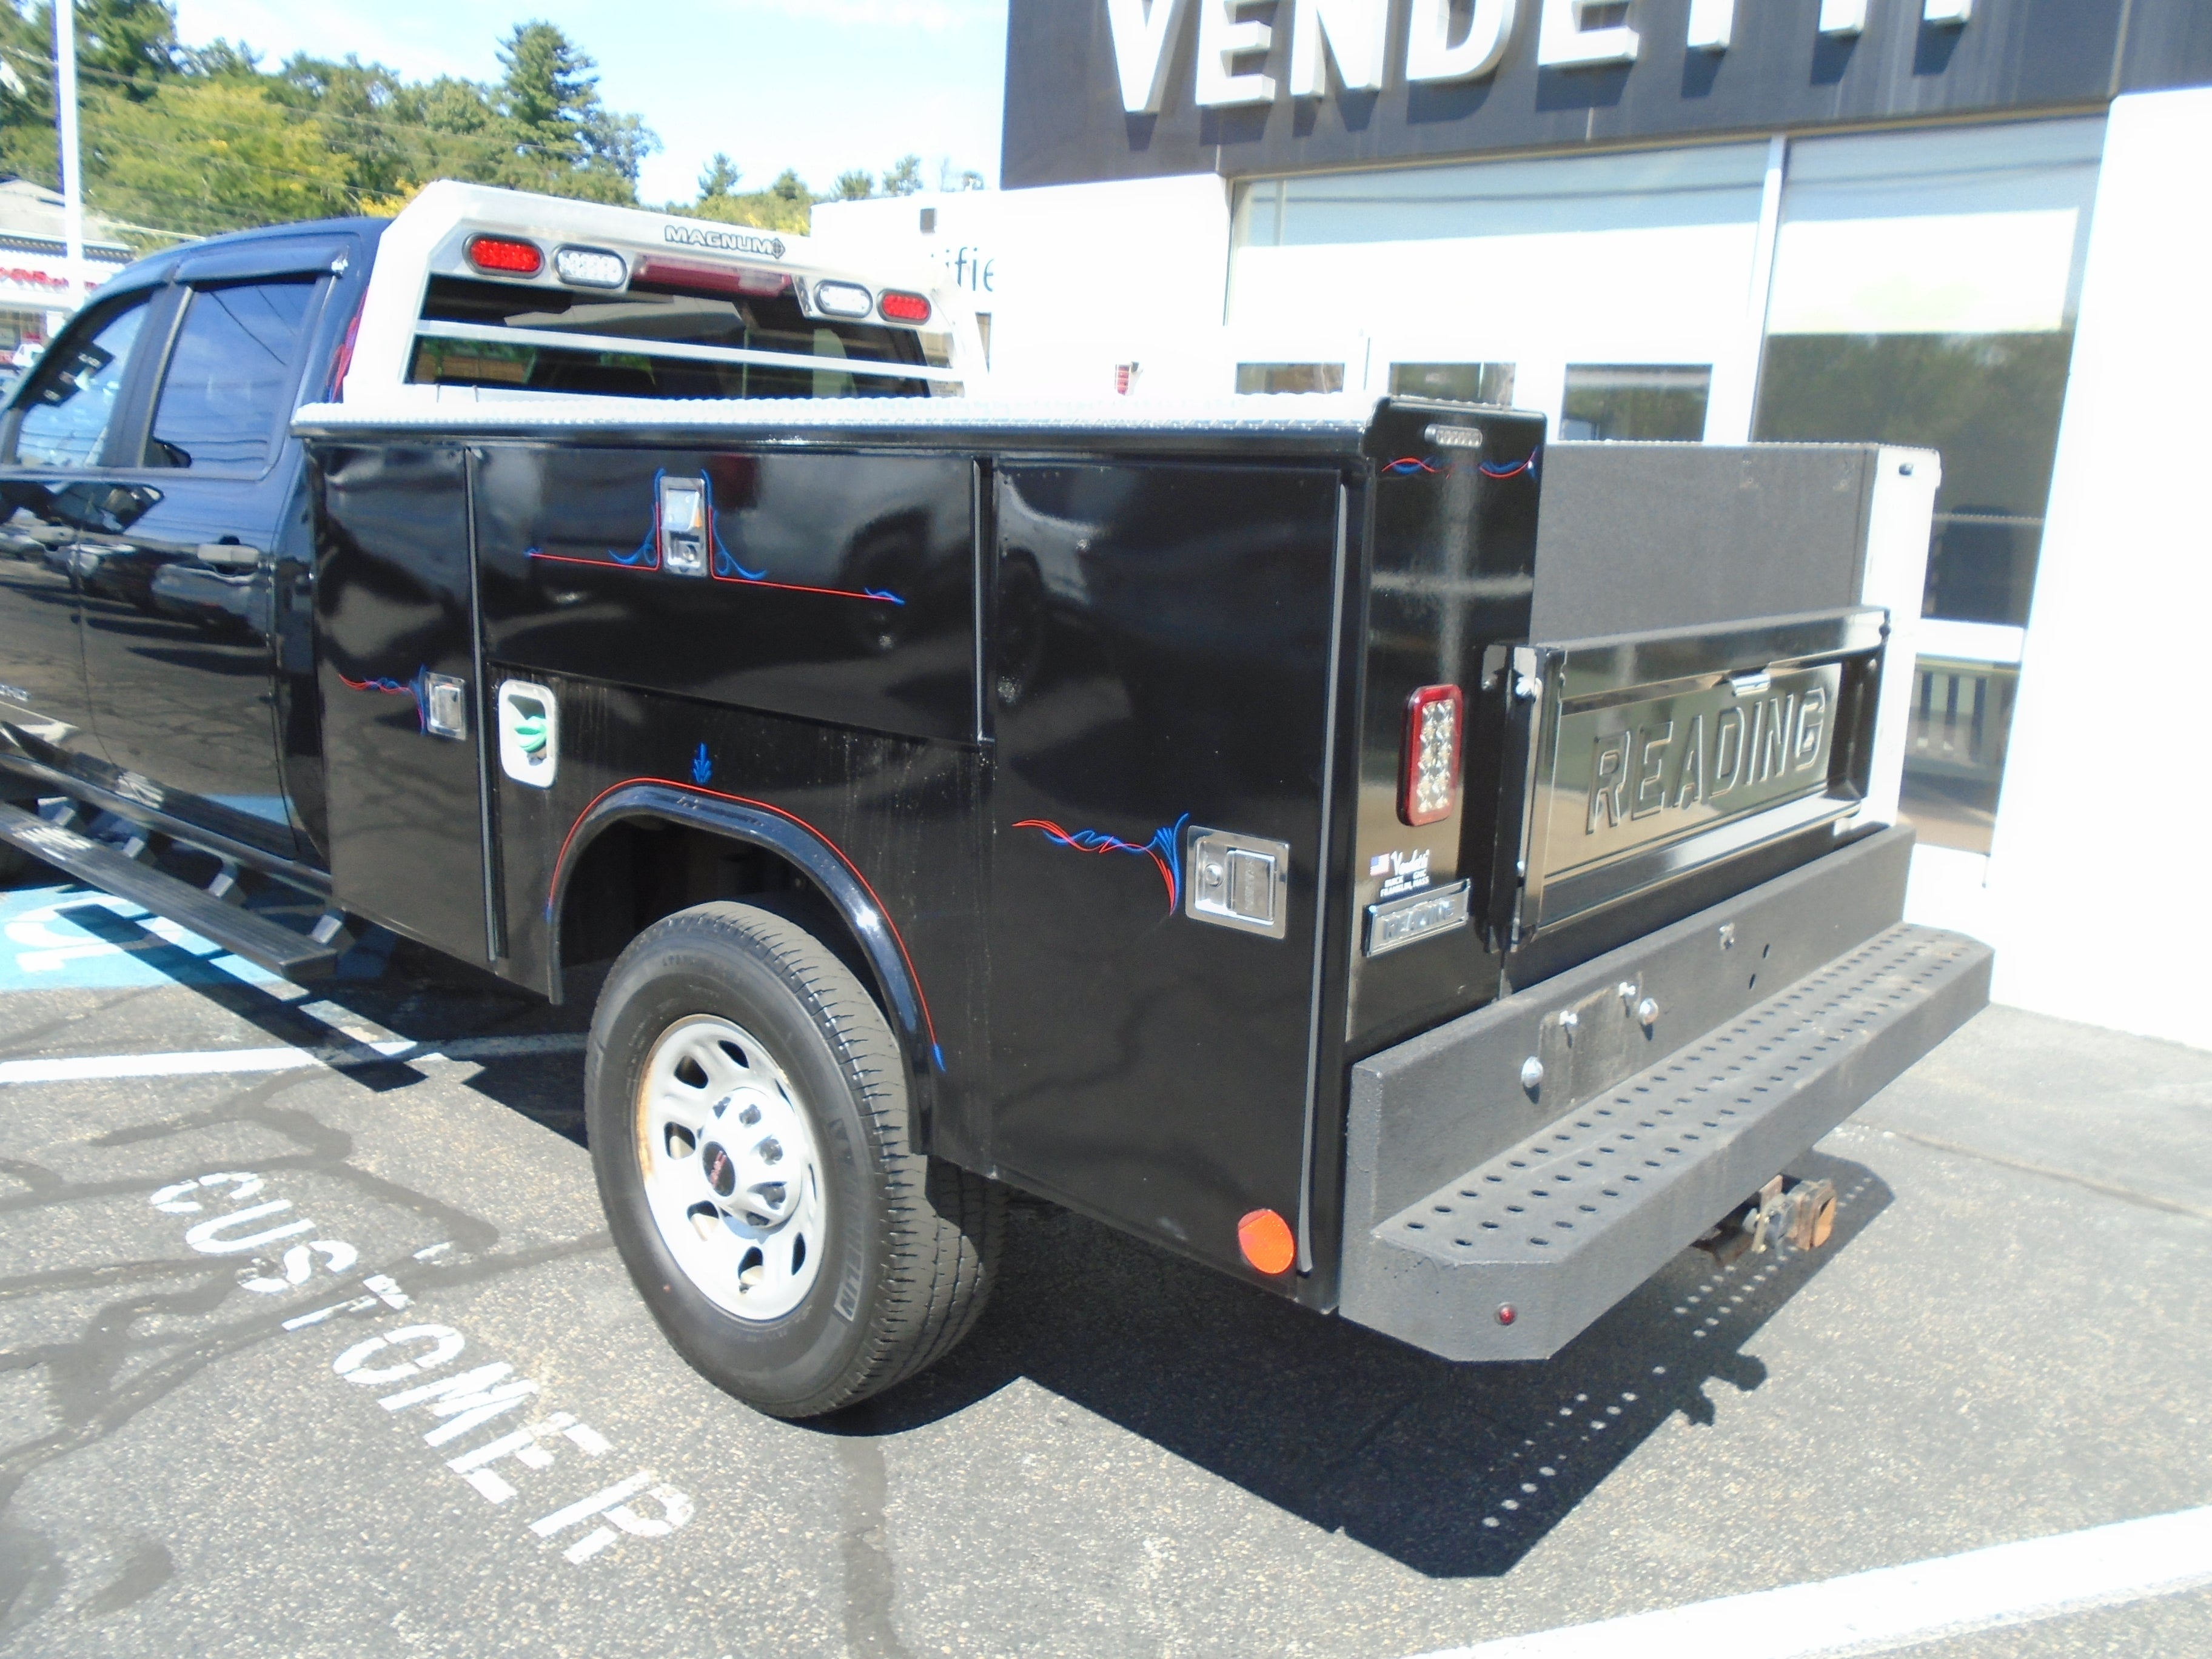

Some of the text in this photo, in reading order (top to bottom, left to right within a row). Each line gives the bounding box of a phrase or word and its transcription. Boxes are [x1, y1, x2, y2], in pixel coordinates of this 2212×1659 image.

[665, 225, 774, 255] MAGNUM
[1584, 686, 1826, 836] READING
[150, 1171, 695, 1565] CUSTOMER
